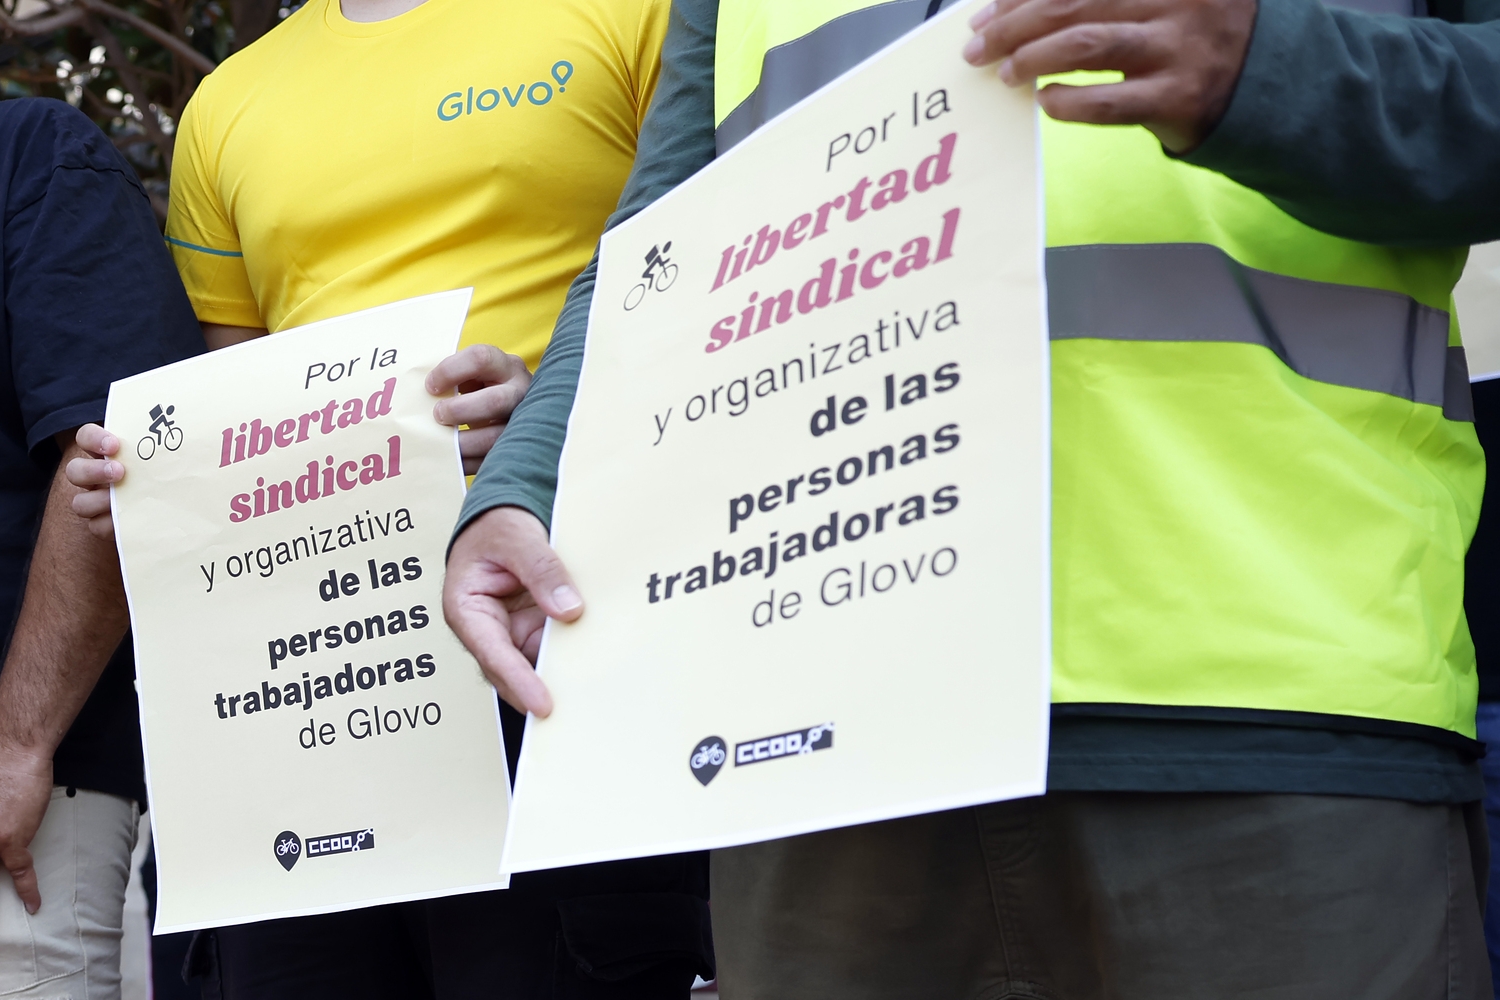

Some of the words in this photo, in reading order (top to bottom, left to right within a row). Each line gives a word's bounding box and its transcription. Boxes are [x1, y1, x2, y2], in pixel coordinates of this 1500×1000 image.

[437, 81, 553, 122] Glovo
[826, 110, 895, 172] Por
[912, 84, 951, 124] la
[709, 133, 958, 294] libertad
[705, 208, 961, 354] sindical
[305, 359, 359, 390] Por
[371, 346, 398, 370] la
[653, 409, 673, 445] y
[686, 300, 960, 418] organizativa
[809, 395, 867, 438] de
[884, 362, 960, 411] las
[218, 377, 397, 468] libertad
[229, 435, 401, 524] sindical
[728, 416, 961, 533] personas
[200, 562, 217, 593] y
[226, 507, 414, 580] organizativa
[319, 568, 362, 601] de
[370, 552, 423, 590] las
[646, 479, 960, 605] trabajadoras
[752, 584, 802, 628] de
[821, 541, 959, 607] Glovo
[268, 603, 429, 669] personas
[214, 650, 436, 719] trabajadoras
[298, 718, 336, 749] de
[347, 702, 442, 740] Glovo
[737, 733, 802, 763] CCOO
[308, 835, 353, 854] CCOO
